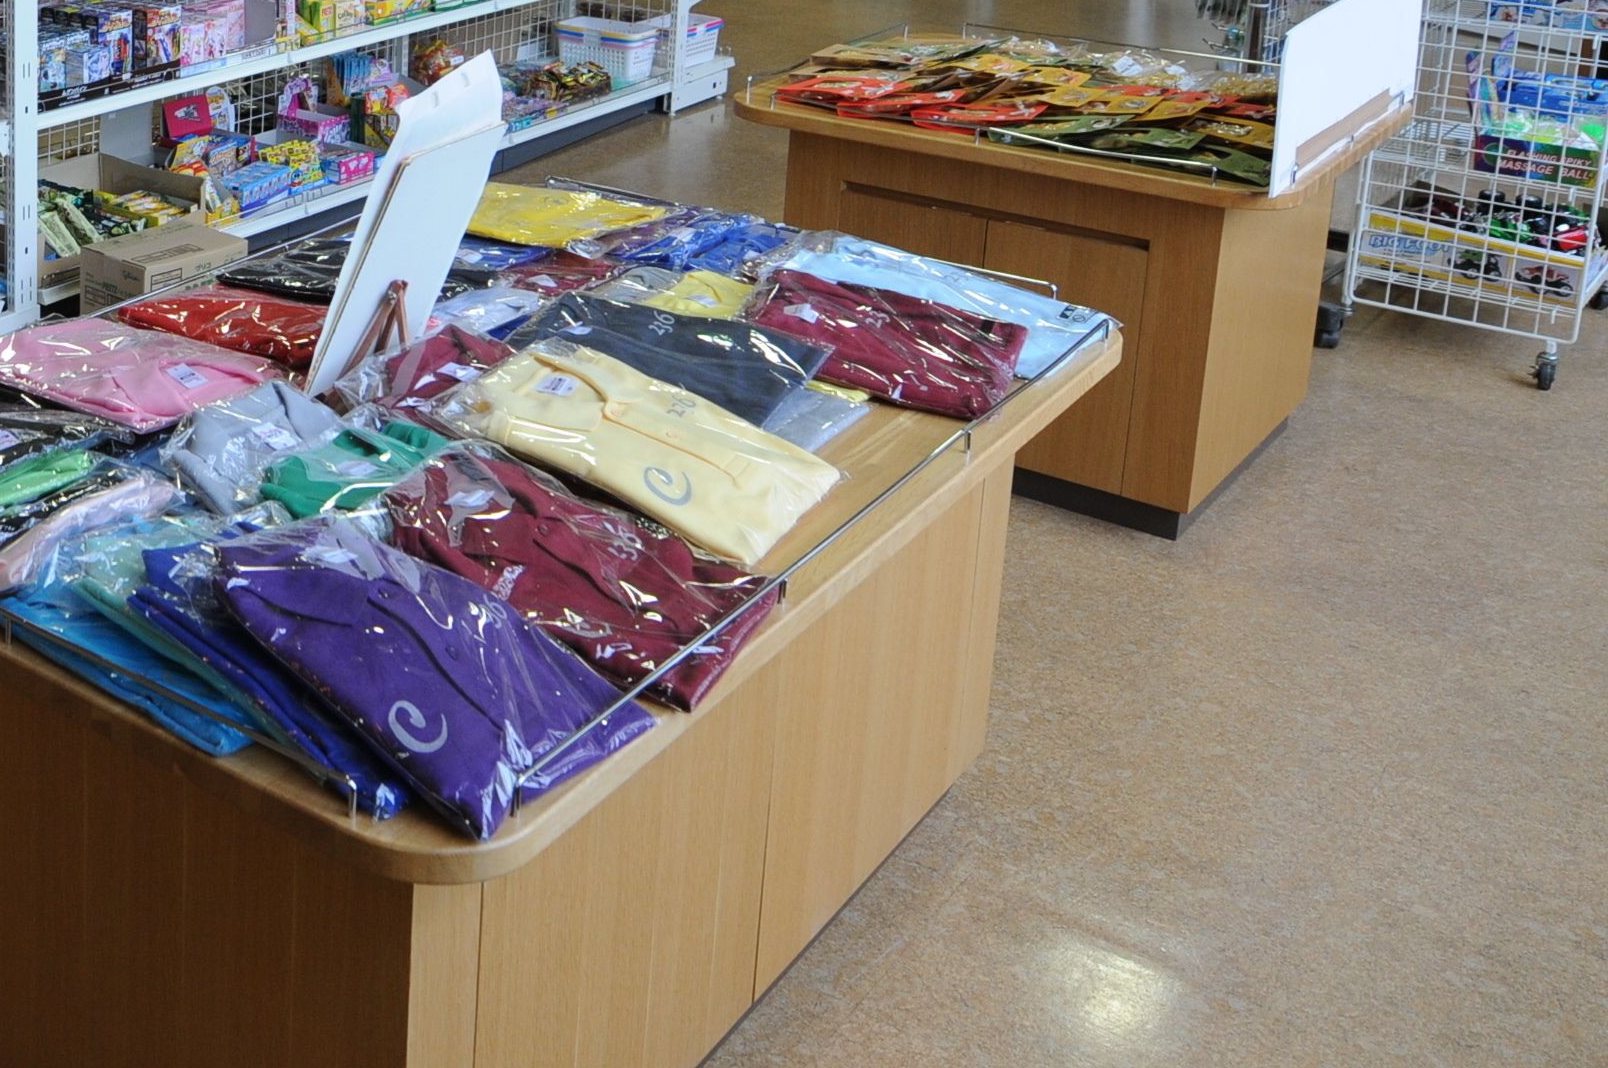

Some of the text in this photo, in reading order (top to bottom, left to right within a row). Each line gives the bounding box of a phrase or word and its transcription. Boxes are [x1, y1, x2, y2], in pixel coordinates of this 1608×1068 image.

[1506, 148, 1558, 162] FLASHING
[1498, 159, 1554, 175] MASSAGE
[1369, 234, 1399, 248] BIG
